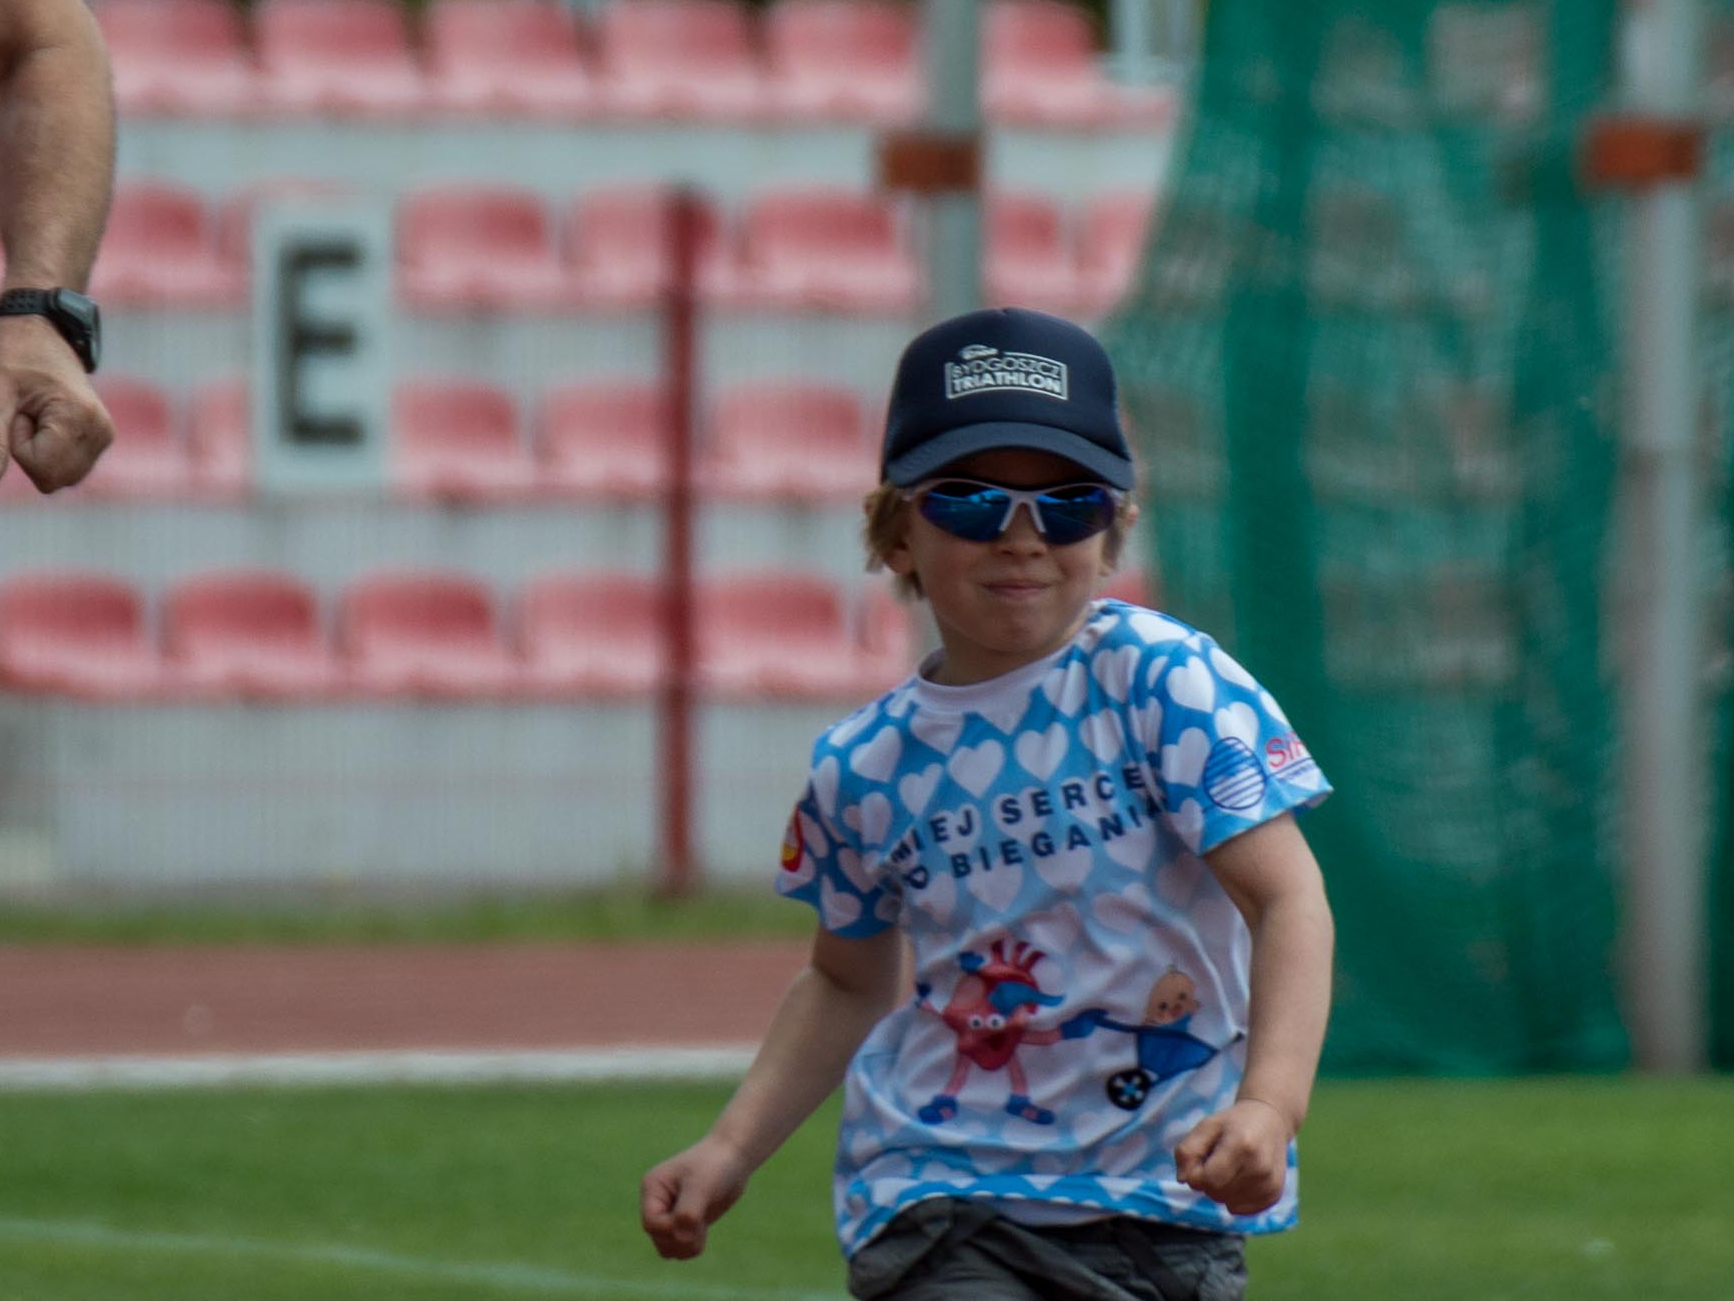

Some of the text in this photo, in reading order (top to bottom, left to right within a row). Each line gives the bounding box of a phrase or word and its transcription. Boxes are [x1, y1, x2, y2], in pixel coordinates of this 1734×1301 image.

[275, 237, 365, 446] E
[951, 357, 1060, 379] BYDGOSZCZ
[952, 371, 1062, 393] TRIATHLON
[1000, 765, 1146, 825] SERCE
